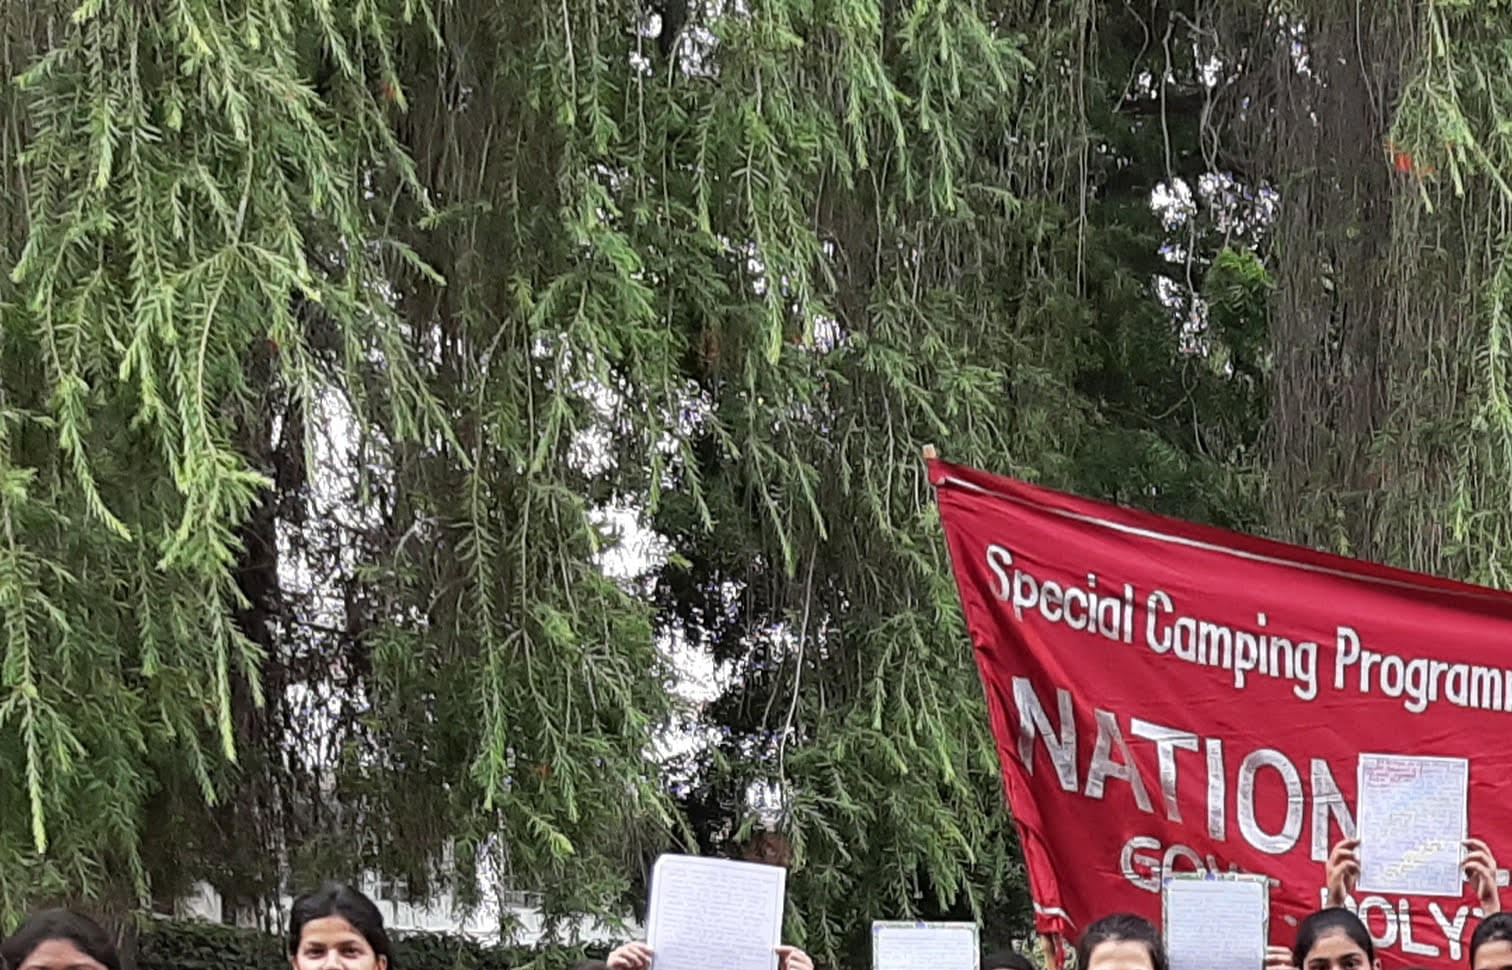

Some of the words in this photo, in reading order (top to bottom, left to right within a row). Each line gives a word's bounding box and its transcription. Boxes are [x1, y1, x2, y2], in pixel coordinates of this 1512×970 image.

[985, 544, 1133, 643] Special
[1146, 590, 1318, 702] Camping
[1010, 675, 1511, 890] NATION
